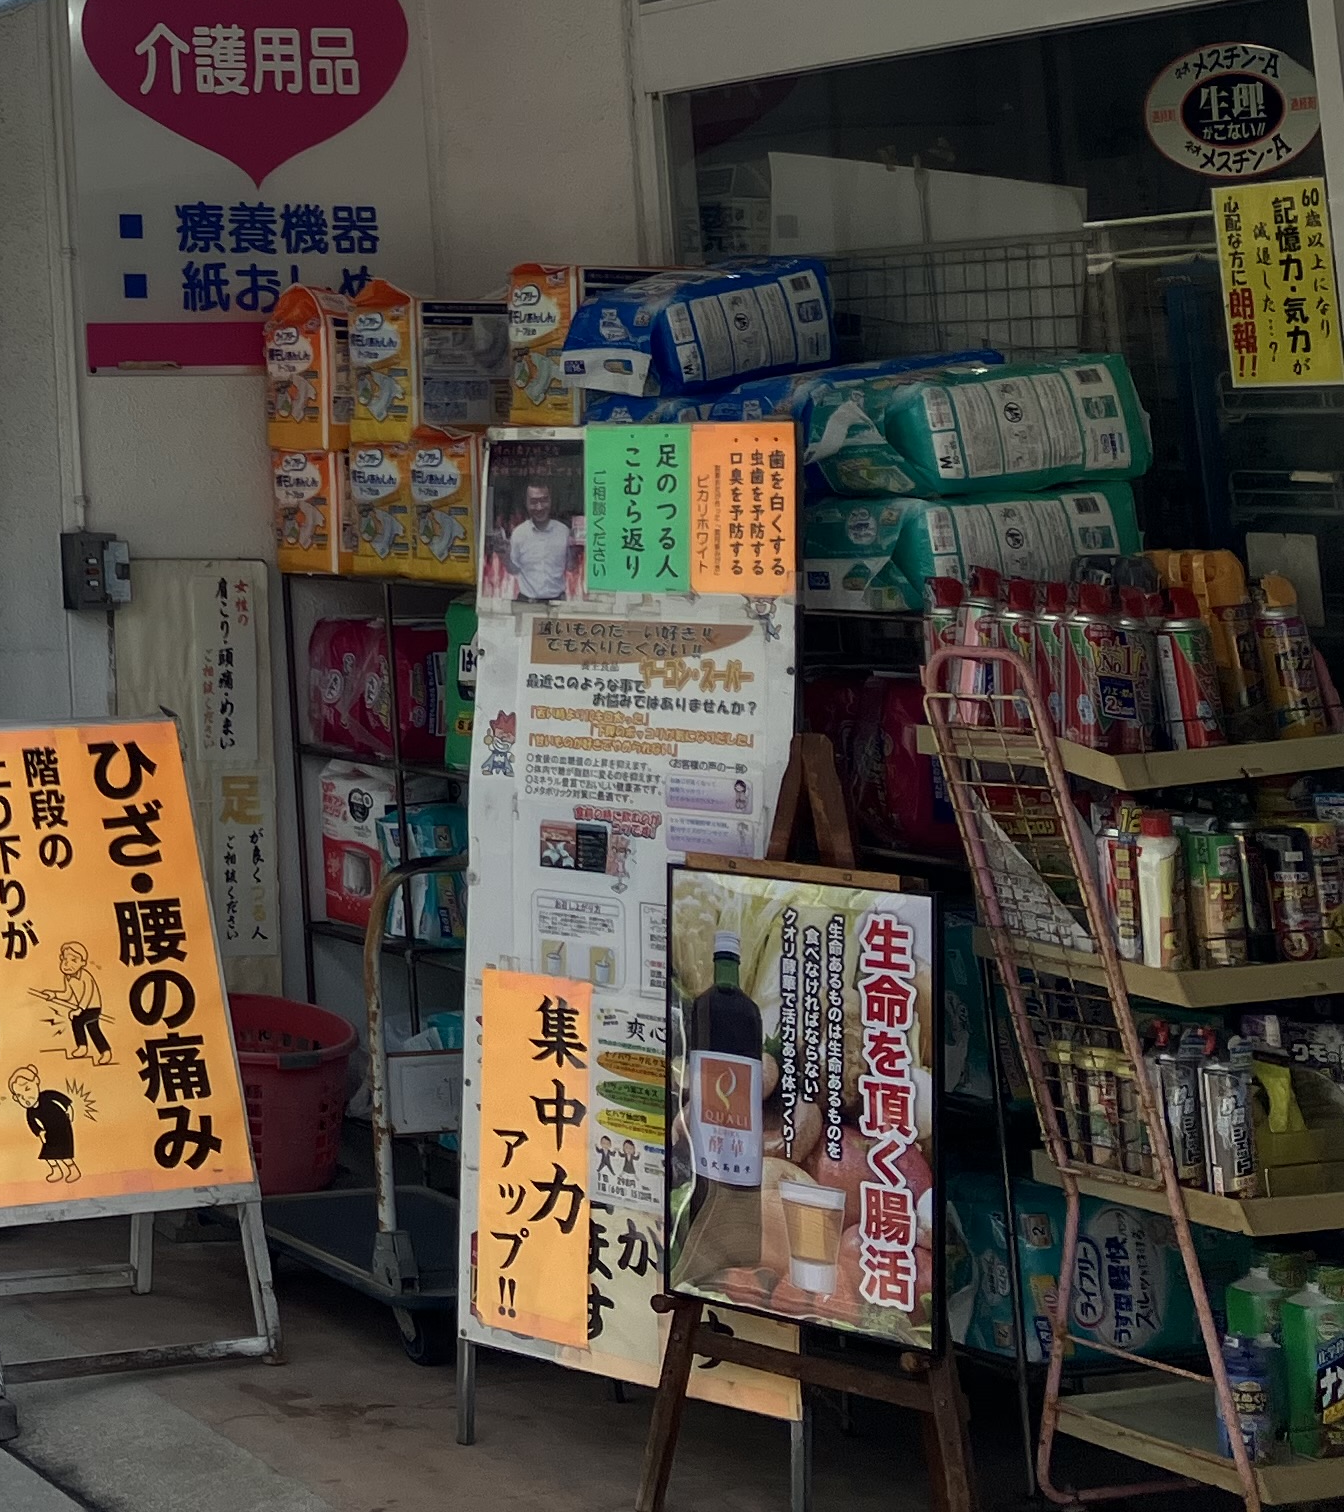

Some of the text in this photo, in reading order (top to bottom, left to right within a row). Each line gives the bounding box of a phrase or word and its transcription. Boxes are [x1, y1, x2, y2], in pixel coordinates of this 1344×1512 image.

[135, 22, 361, 96] 介護用品
[1199, 81, 1266, 123] 生理
[175, 201, 380, 255] 療養機器
[1302, 188, 1331, 339] 60歳以上になり
[1272, 196, 1312, 375] 記憶力・気力が
[592, 470, 607, 577] ご相談ください
[696, 474, 709, 574] ピカリホワイト
[233, 578, 250, 627] 女性の
[526, 672, 646, 694] 最近このような事で
[592, 692, 758, 716] お悩みではありませんか?
[638, 657, 755, 693] ヤーコン・スーパー
[21, 746, 73, 870] 階段の
[218, 774, 265, 826] 足
[87, 740, 223, 1170] ひざ・腰の痛み
[527, 994, 590, 1235] 集中力
[704, 1109, 749, 1129] QUALI
[859, 912, 918, 1314] 生命を頂く腸活
[490, 1125, 531, 1319] アップ!!
[1078, 1246, 1098, 1319] ライフリー
